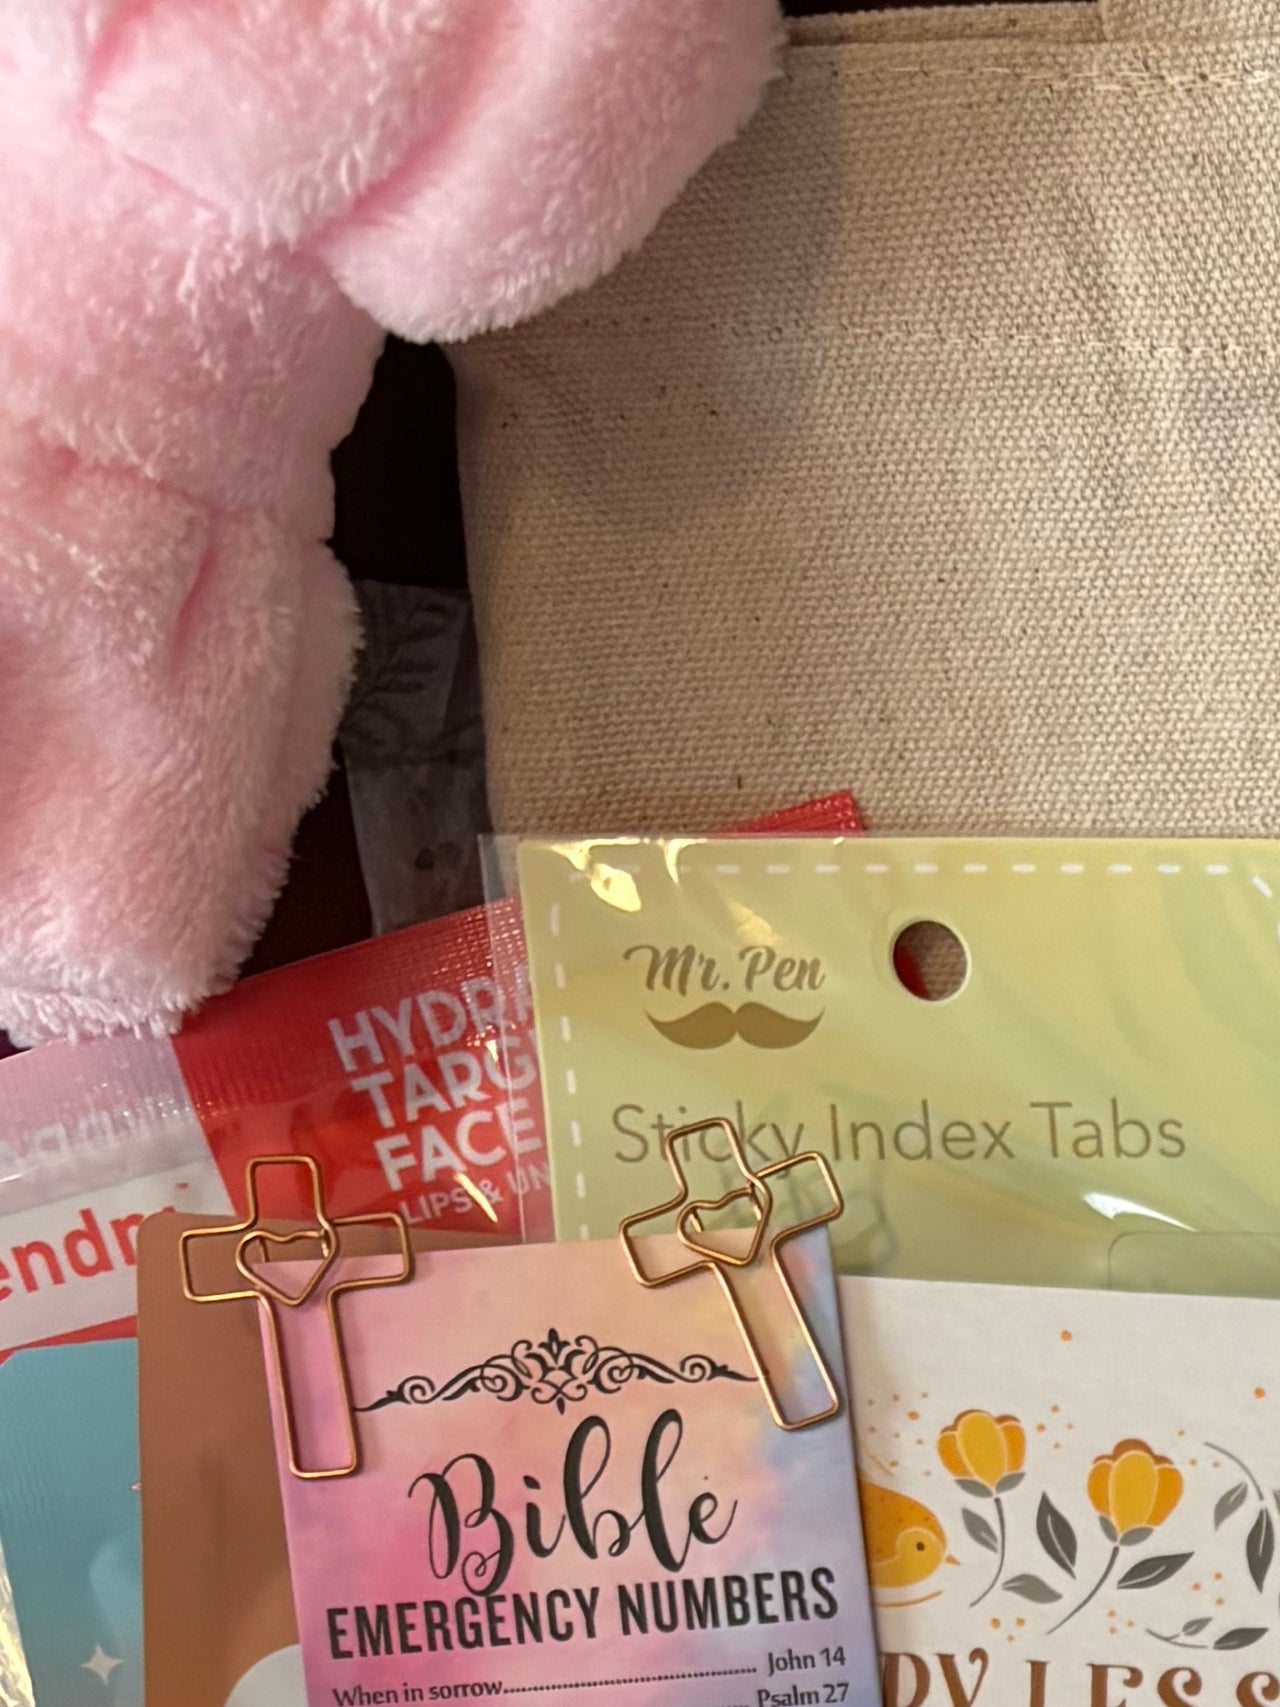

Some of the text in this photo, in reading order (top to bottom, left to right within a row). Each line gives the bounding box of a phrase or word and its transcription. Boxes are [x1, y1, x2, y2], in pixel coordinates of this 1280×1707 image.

[623, 944, 827, 996] Mr. Pen
[350, 1030, 538, 1129] TARG
[373, 1097, 542, 1191] FACE
[611, 1099, 1187, 1178] Sticky Index Tabs
[408, 1407, 739, 1599] Bible
[326, 1565, 840, 1662] EMERGENCY NUMBERS
[331, 1645, 846, 1707] When in sorrow John 14
[756, 1683, 819, 1707] Psalm
[821, 1681, 849, 1703] 27
